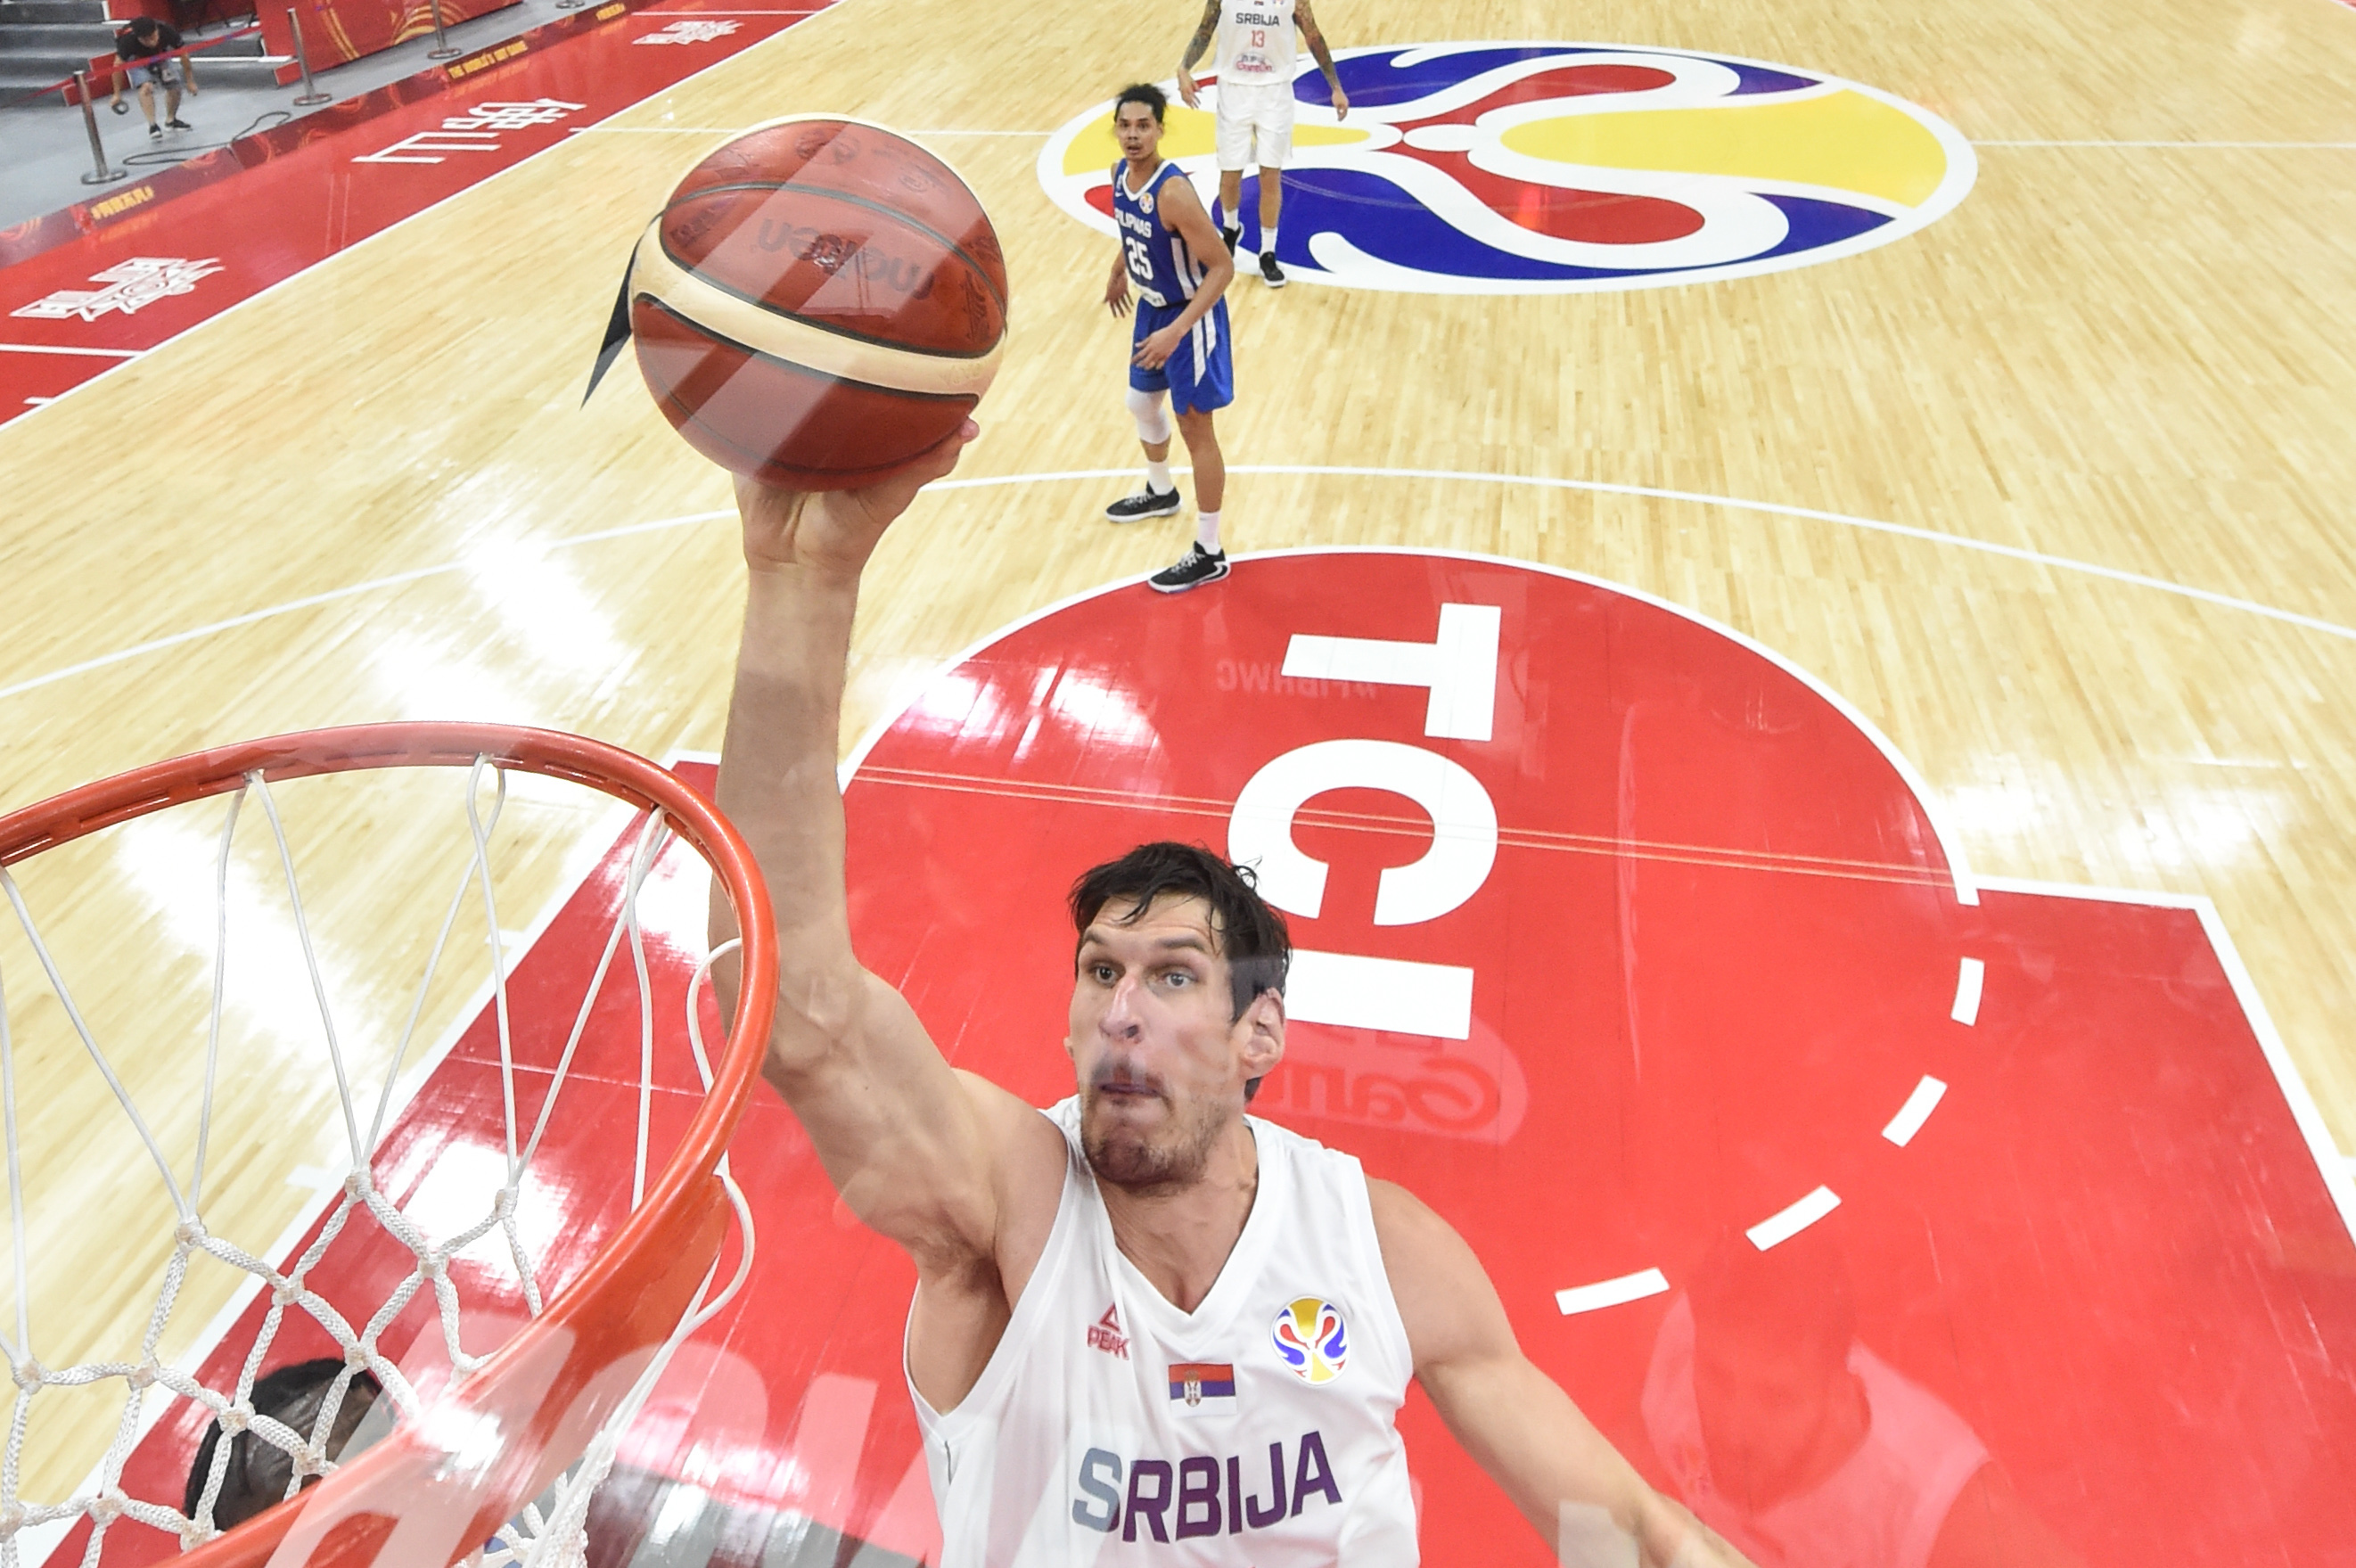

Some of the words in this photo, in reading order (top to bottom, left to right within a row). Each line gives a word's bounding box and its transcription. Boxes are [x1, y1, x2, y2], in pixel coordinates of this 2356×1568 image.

[1235, 12, 1280, 26] SRBIJA
[1252, 29, 1265, 47] 13
[350, 98, 587, 164] 佛山
[1126, 236, 1153, 280] 25
[1088, 1325, 1129, 1360] PEAK
[1072, 1431, 1342, 1543] SRBIJA
